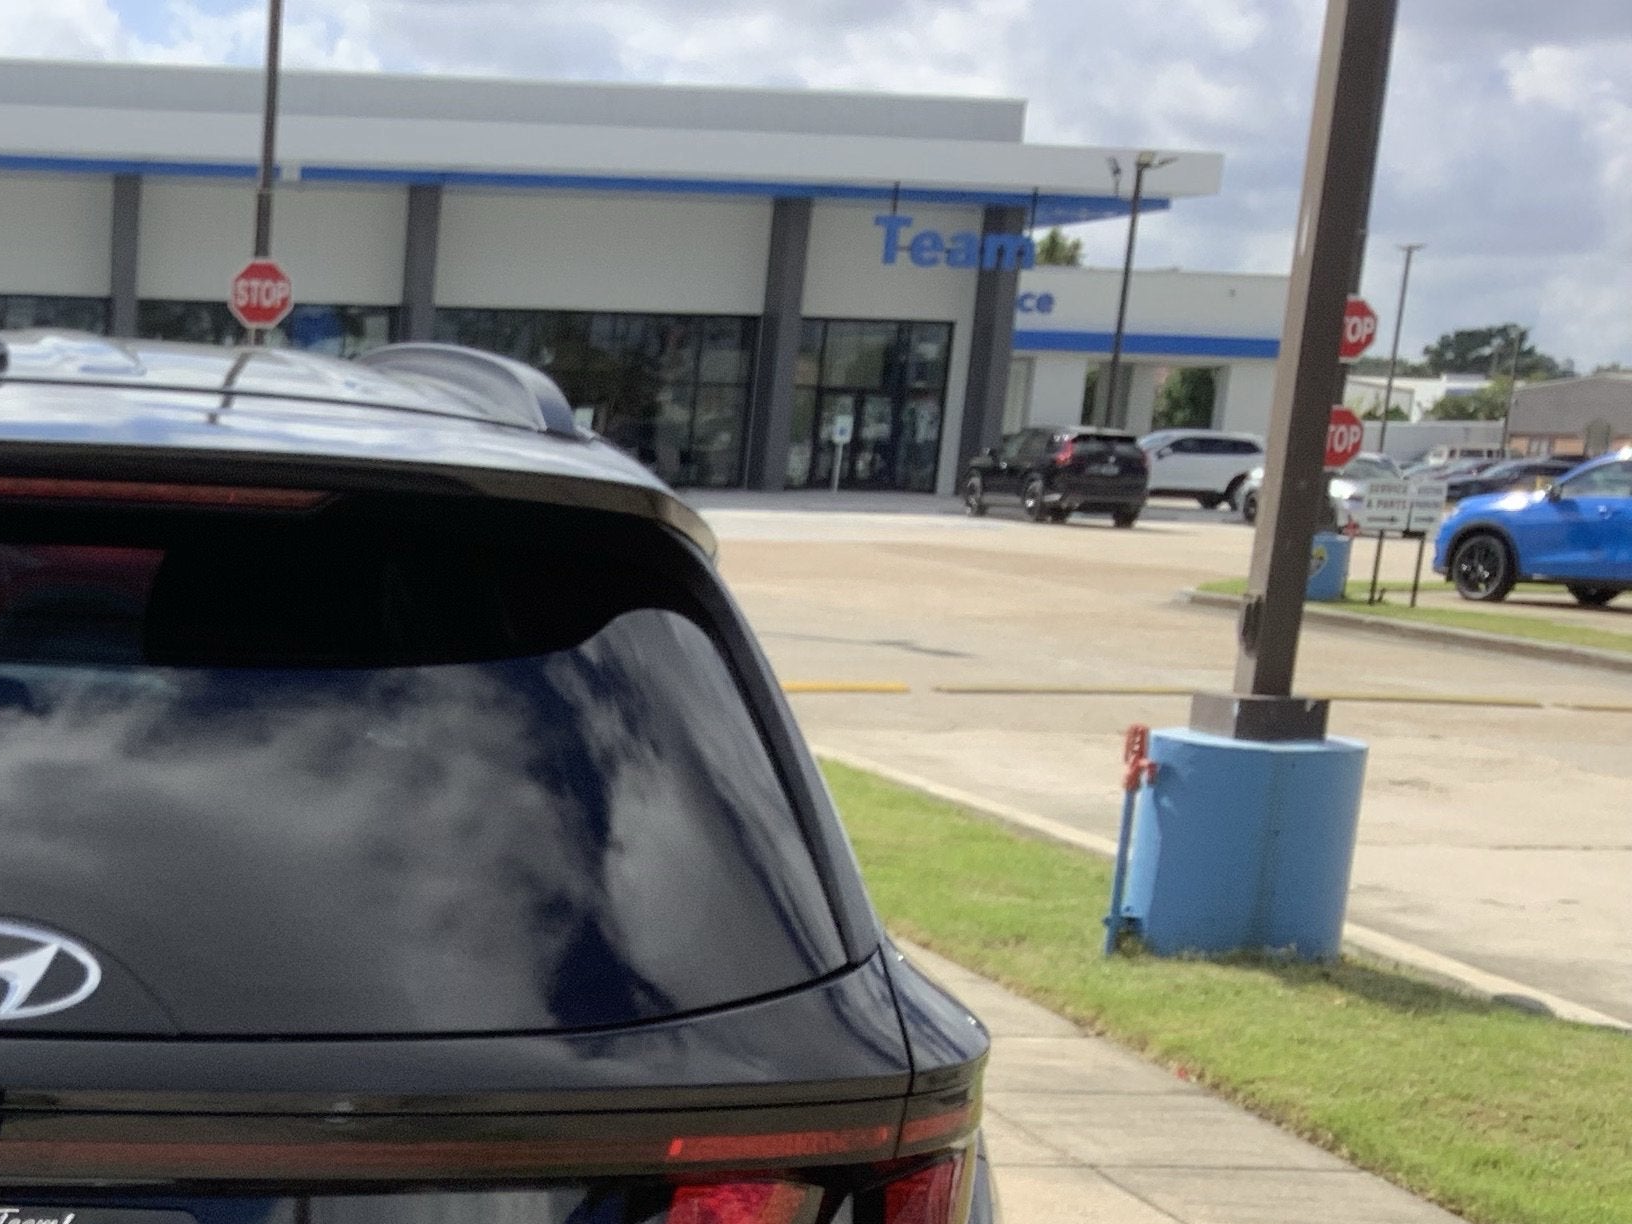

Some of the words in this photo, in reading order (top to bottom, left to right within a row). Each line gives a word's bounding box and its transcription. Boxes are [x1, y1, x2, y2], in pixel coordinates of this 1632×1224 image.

[873, 214, 1036, 270] Team
[235, 279, 290, 309] STOP
[1326, 424, 1361, 453] TOP
